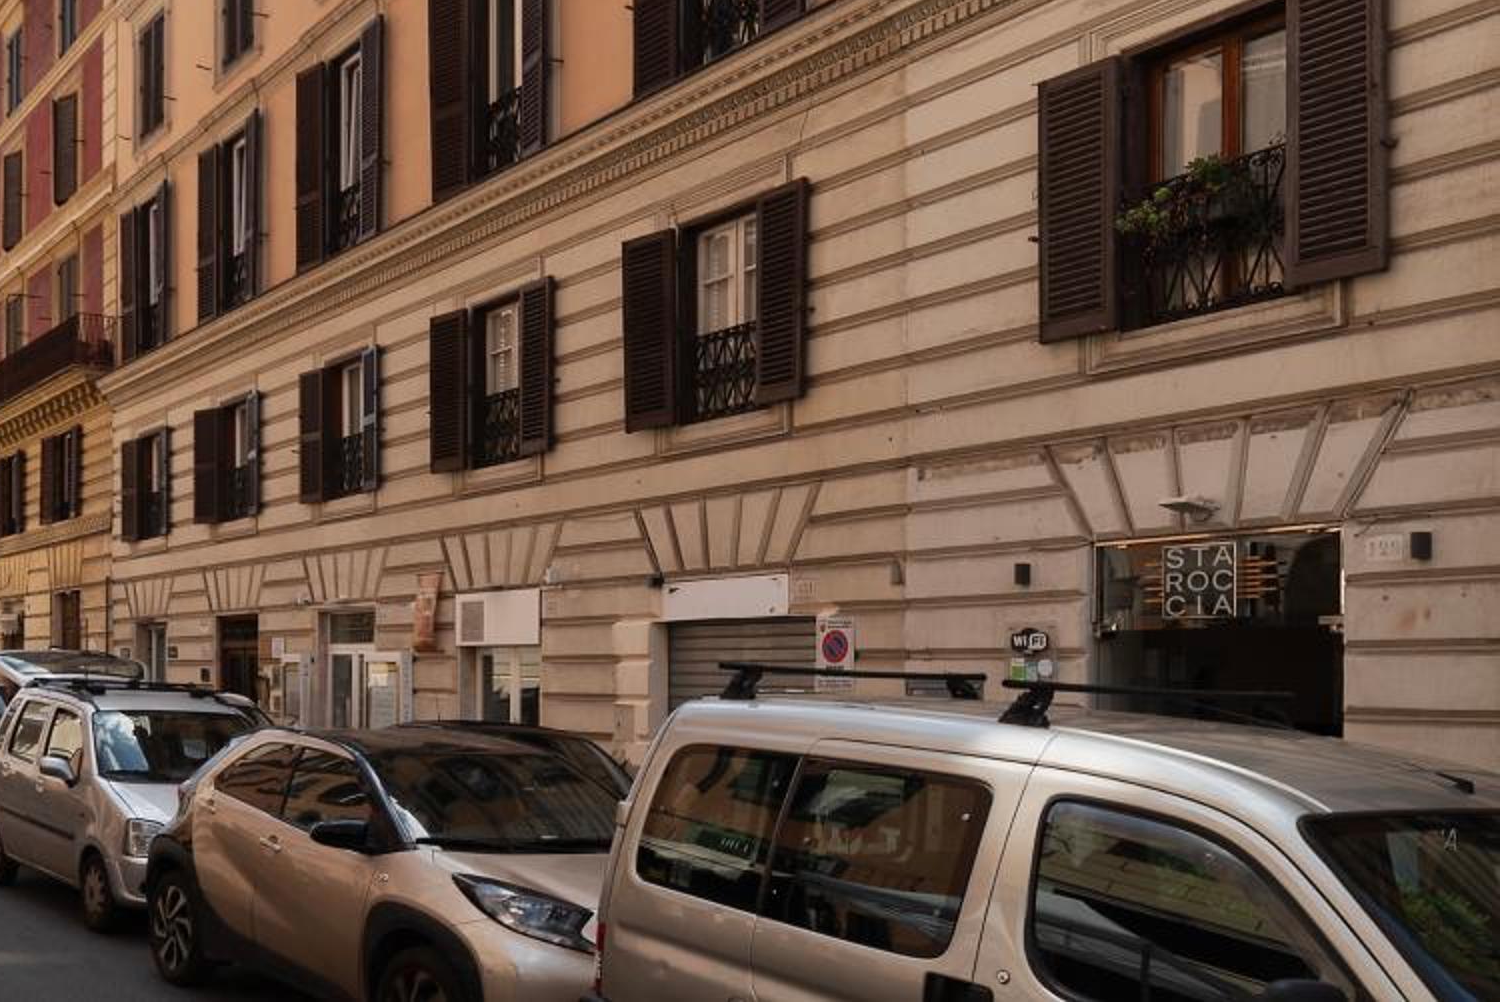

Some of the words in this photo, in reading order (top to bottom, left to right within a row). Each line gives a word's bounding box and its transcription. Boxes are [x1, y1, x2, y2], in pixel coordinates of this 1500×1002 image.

[1165, 546, 1232, 569] STA
[1165, 569, 1232, 593] ROC
[1165, 594, 1232, 615] CIA
